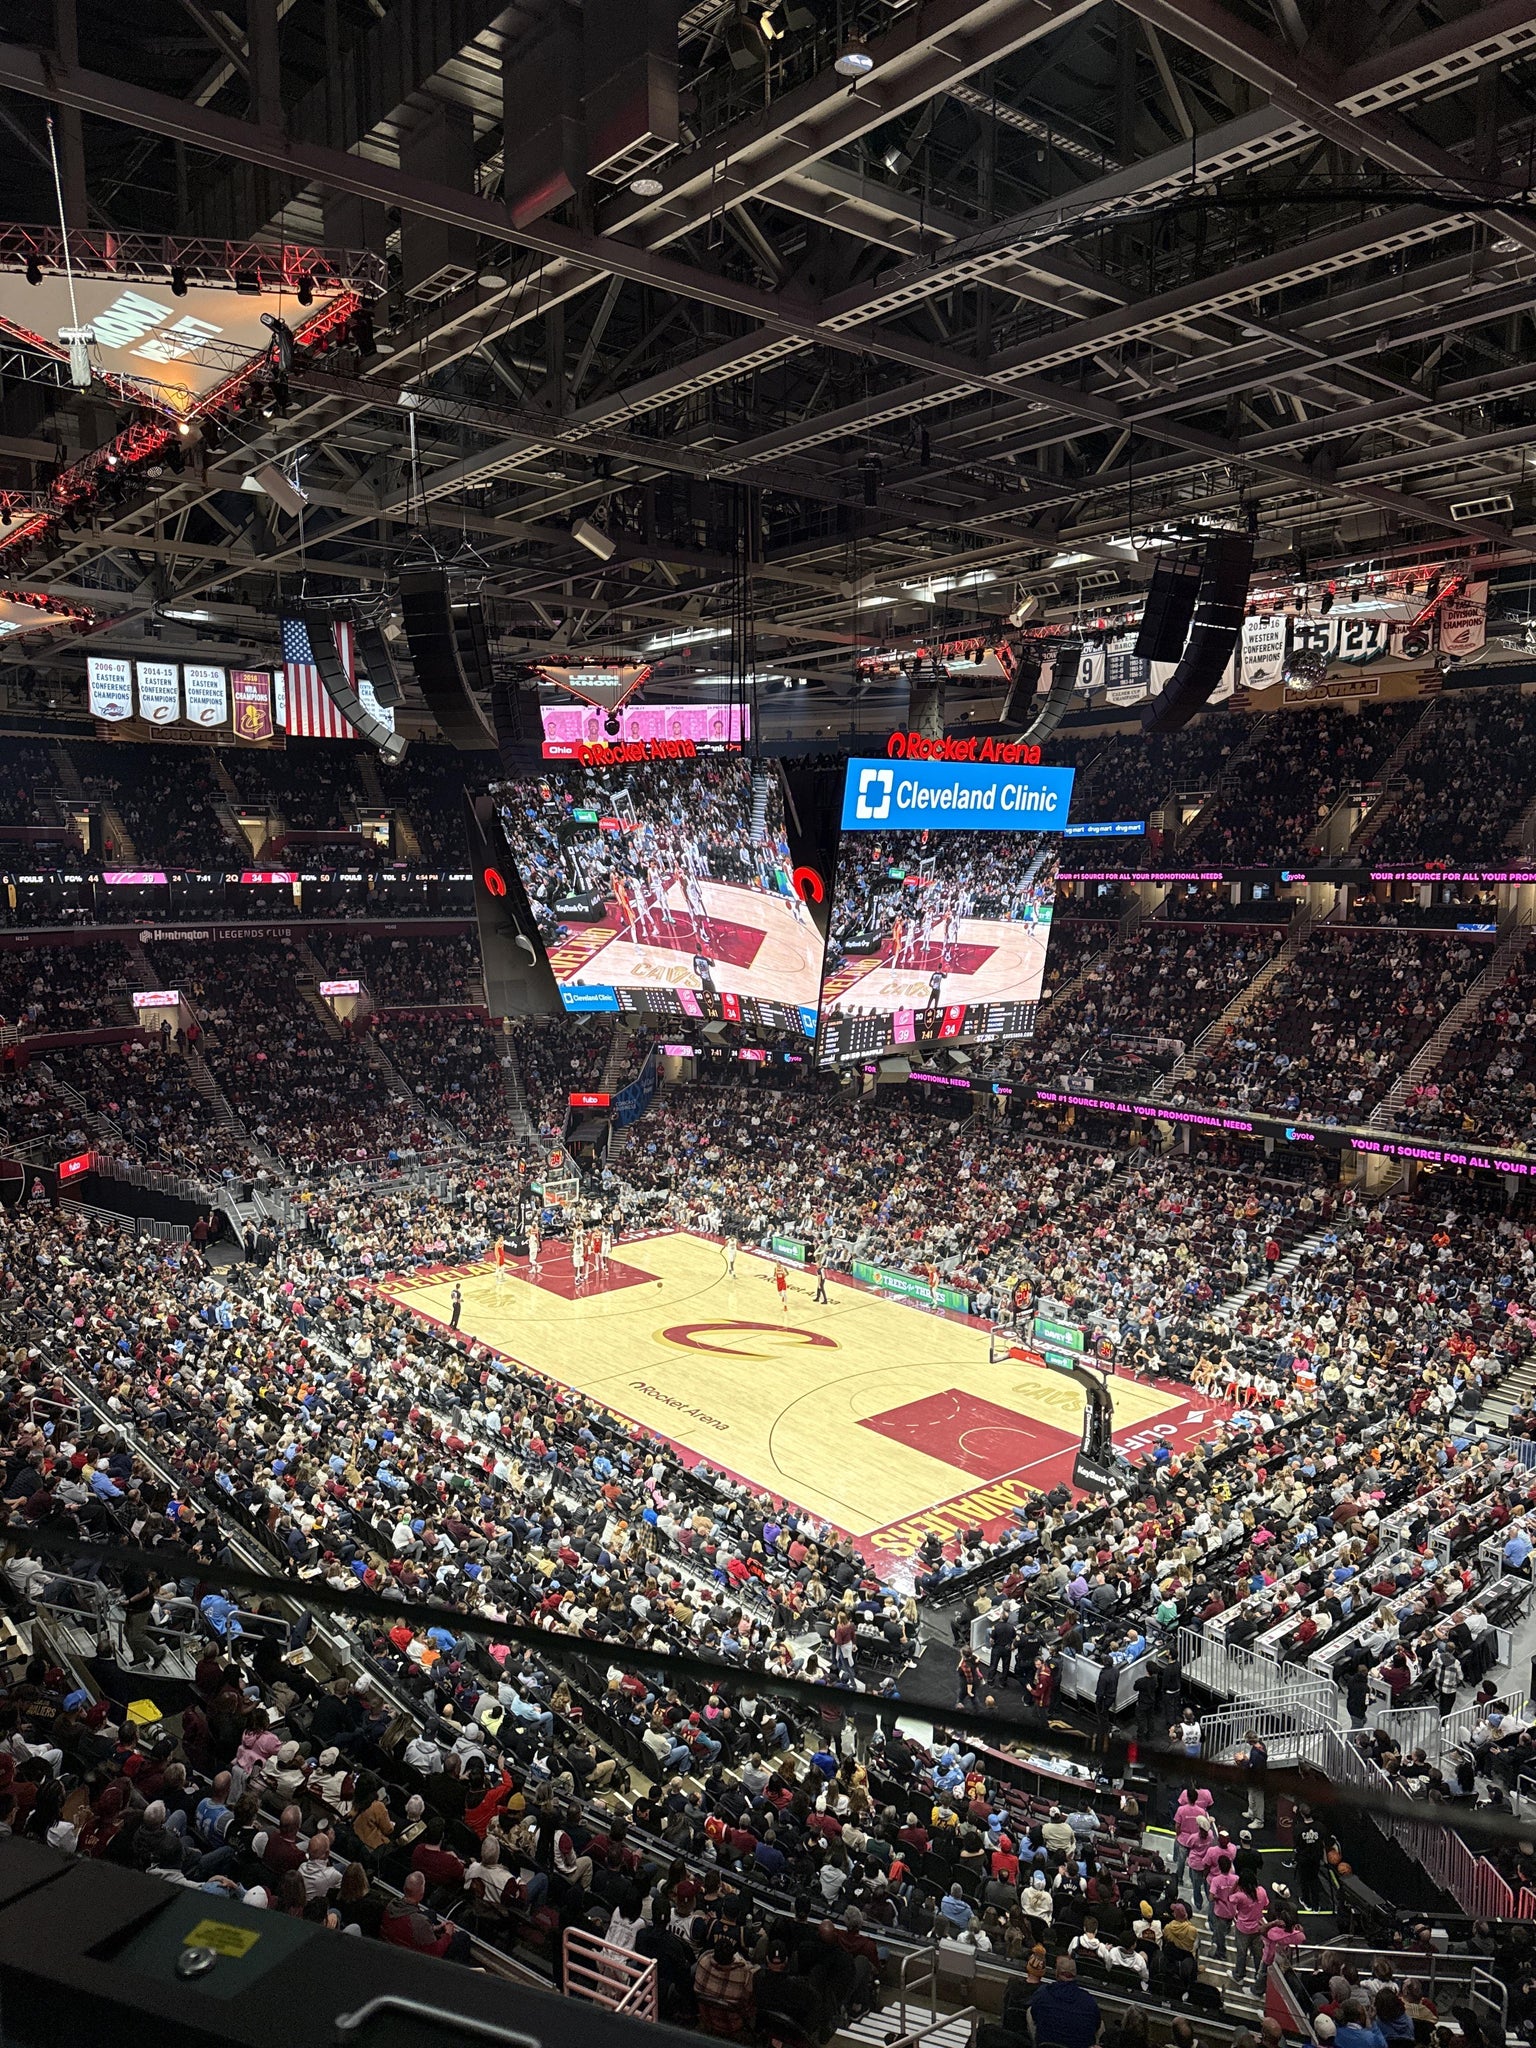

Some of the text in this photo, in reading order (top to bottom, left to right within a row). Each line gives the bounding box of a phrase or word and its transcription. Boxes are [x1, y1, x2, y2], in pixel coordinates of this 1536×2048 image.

[1448, 609, 1478, 619] DIVISION
[1443, 618, 1482, 630] CHAMPIONS
[1249, 632, 1278, 643] WESTERN
[1345, 621, 1379, 650] 27
[1243, 642, 1283, 654] CONFERENCE
[1244, 653, 1281, 664] CHAMPIONS
[95, 663, 125, 672] 2006-07
[143, 667, 173, 676] 2014-15
[1082, 658, 1093, 684] 9
[97, 674, 125, 682] EASTERN
[191, 670, 219, 678] 2015-16
[92, 682, 131, 691] CONFERENCE
[145, 678, 171, 686] EASTERN
[192, 680, 218, 688] EASTERN
[141, 686, 177, 694] CONFERENCE
[188, 688, 224, 697] CONFERENCE
[245, 685, 257, 693] NBA
[94, 691, 129, 700] CHAMPIONS
[142, 694, 176, 703] CHAMPIONS
[235, 692, 268, 702] CHAMPIONS
[190, 697, 222, 705] CHAMPIONS
[549, 746, 572, 754] Ohio
[593, 737, 696, 766] Rocket Arena
[907, 733, 1041, 764] Rocket Arena
[897, 780, 1058, 812] Cleveland Clinic
[88, 875, 99, 883] 44
[1481, 873, 1507, 881] YOUR
[154, 929, 291, 942] Huntington LEGENDS CLUB
[727, 1008, 737, 1018] 34
[921, 1031, 933, 1039] 7:41
[945, 1025, 955, 1035] 34
[898, 1030, 909, 1041] 39
[865, 1065, 877, 1073] FOR
[950, 1078, 970, 1088] NEEDS
[582, 1096, 598, 1104] fubo
[1036, 1091, 1252, 1131] YOUR #1 SOURCE FOR ALL YOUR PROMOTIONAL NEEDS
[1351, 1138, 1380, 1151] YOUR
[1383, 1144, 1395, 1153] #1
[1397, 1146, 1441, 1161] SOURCE
[1444, 1153, 1466, 1165] FOR
[1469, 1157, 1491, 1168] ALL
[1494, 1160, 1527, 1175] YOUR
[883, 1276, 908, 1291] TREES
[1101, 1348, 1111, 1356] 24
[642, 1385, 729, 1431] Rocket Arena
[1077, 1465, 1108, 1485] KeyBank
[870, 1479, 1045, 1557] CAVALIERS
